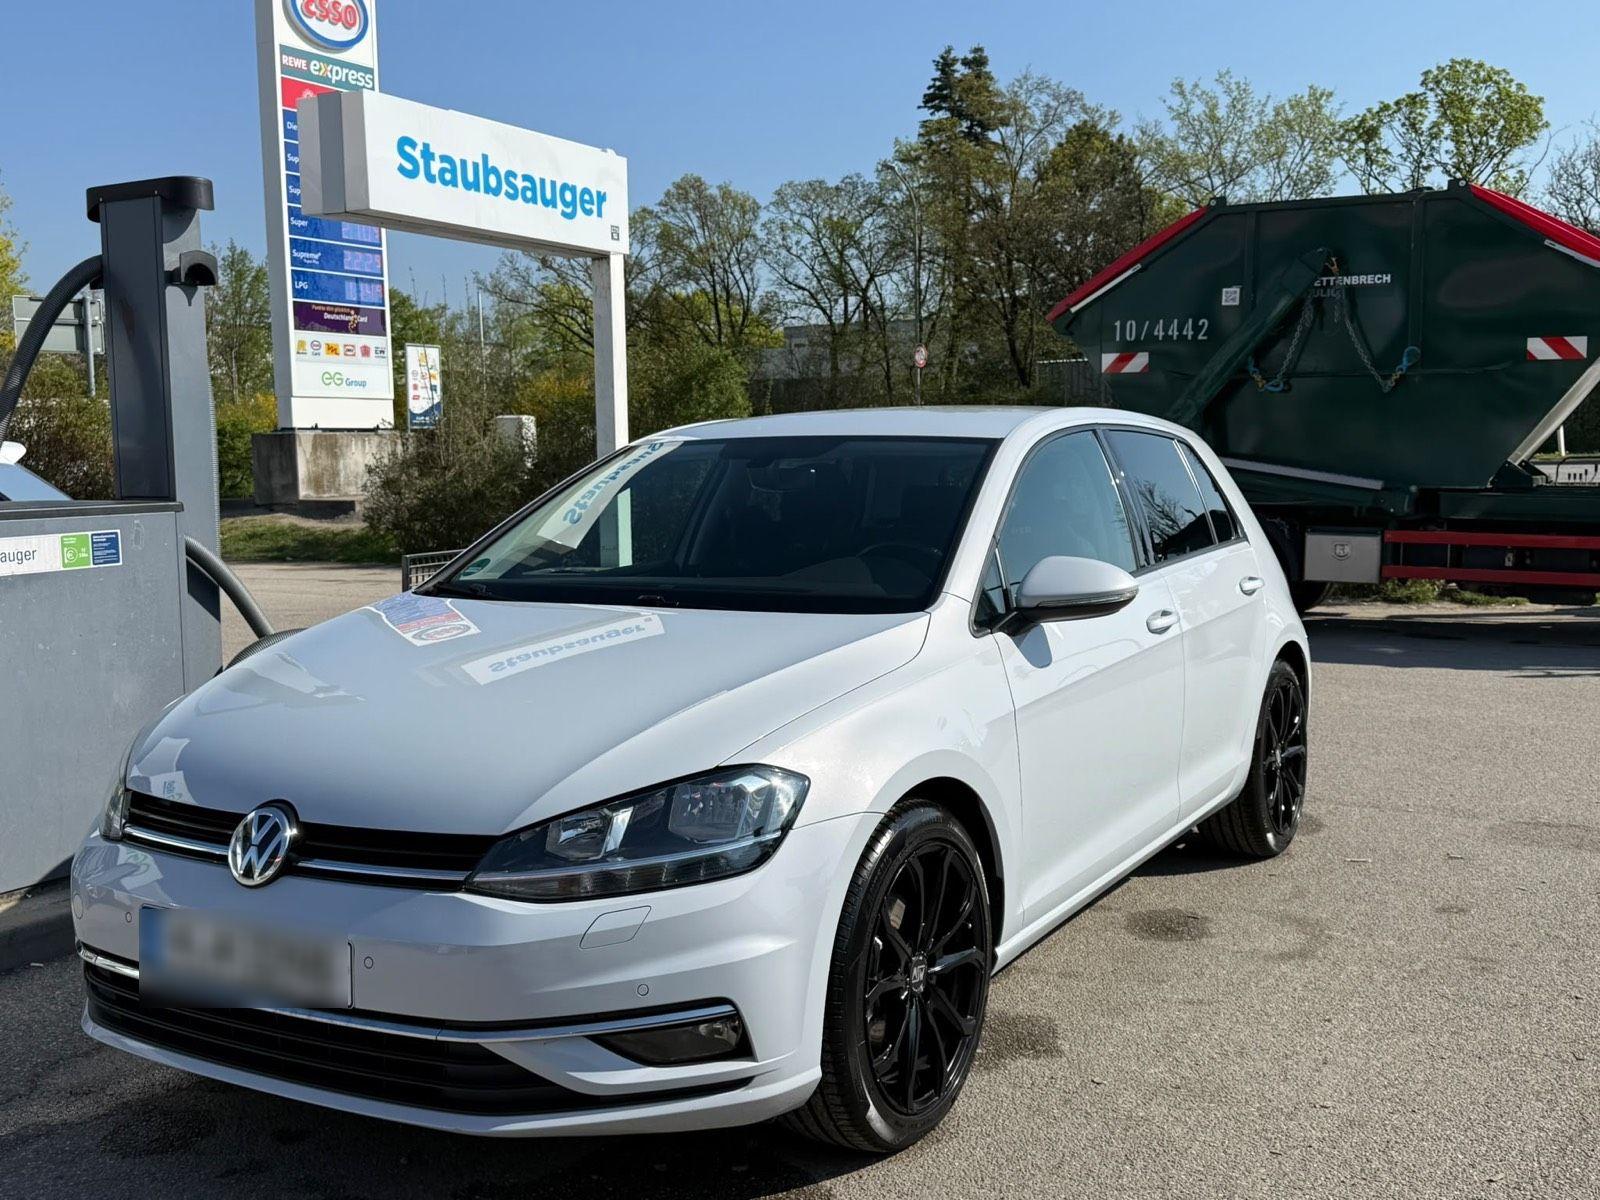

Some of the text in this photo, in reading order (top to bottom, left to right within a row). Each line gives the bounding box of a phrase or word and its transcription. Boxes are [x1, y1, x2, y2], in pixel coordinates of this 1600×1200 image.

[282, 54, 373, 88] REWE express
[396, 135, 607, 220] Staubsauger
[290, 217, 309, 228] Super
[294, 281, 308, 289] LPG
[1114, 318, 1209, 342] 10/4442
[345, 377, 367, 388] Group
